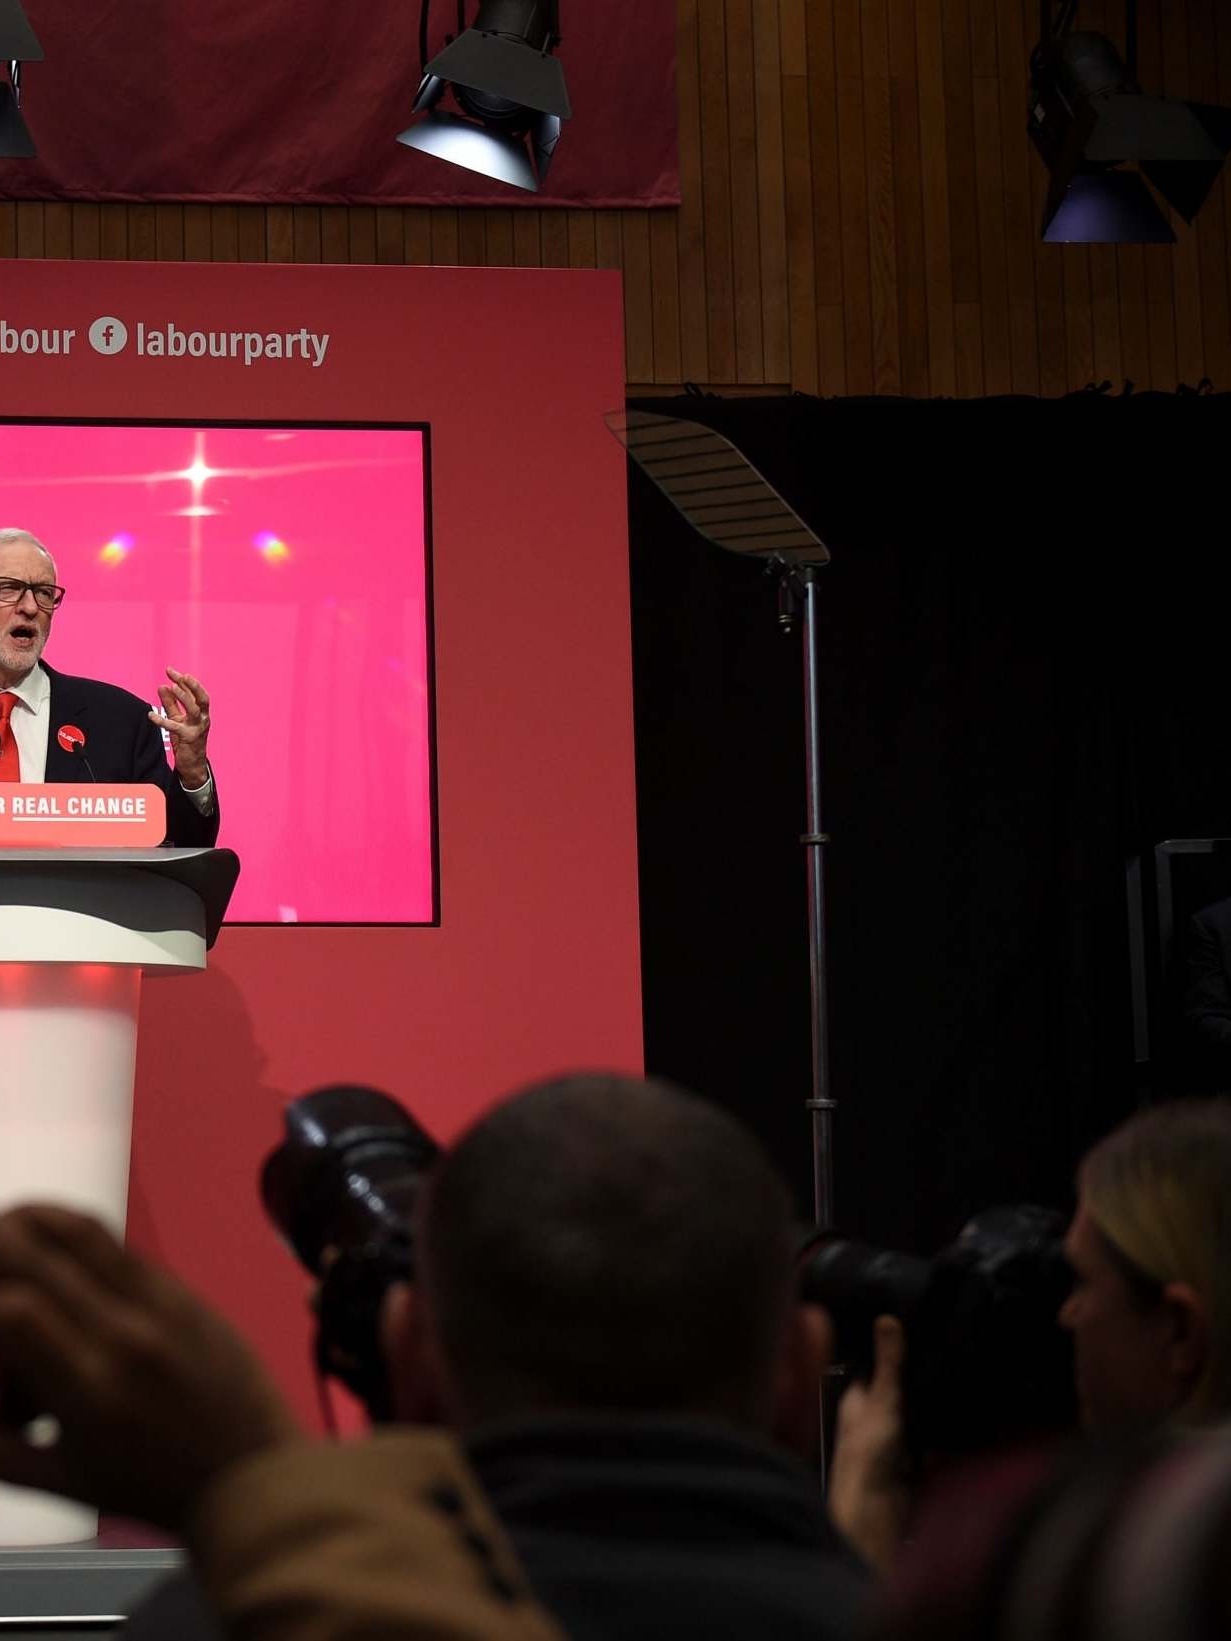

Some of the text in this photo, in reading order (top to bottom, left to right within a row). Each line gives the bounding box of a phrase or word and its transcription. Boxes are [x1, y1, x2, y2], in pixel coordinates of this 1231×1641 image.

[137, 322, 330, 367] labourparty
[12, 797, 61, 815] REAL
[67, 797, 146, 815] CHANGE
